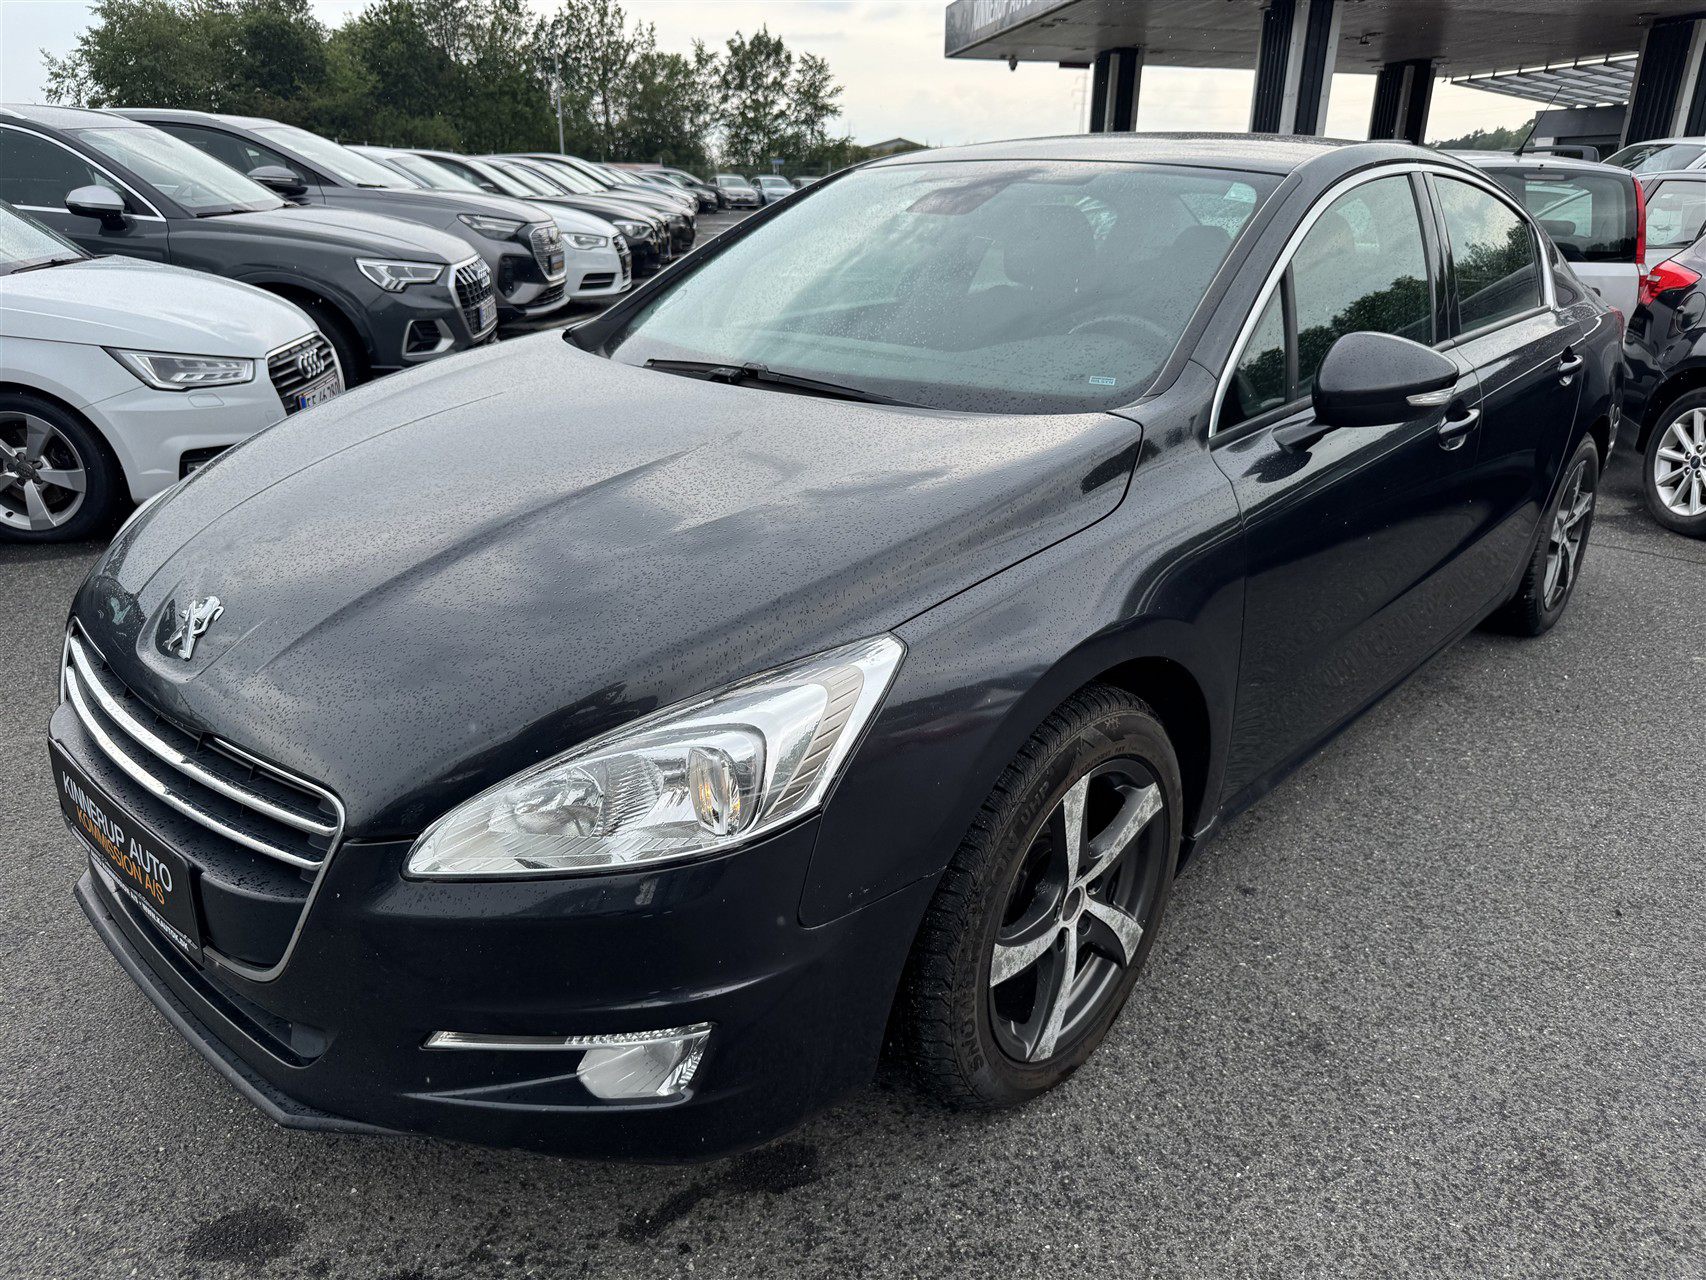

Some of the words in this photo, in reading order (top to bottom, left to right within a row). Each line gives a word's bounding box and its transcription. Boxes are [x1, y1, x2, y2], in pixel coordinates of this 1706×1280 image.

[62, 771, 125, 847] KINNERUP
[129, 837, 173, 892] AUTO
[76, 806, 143, 885] KOMMISSION
[145, 873, 165, 905] A/S
